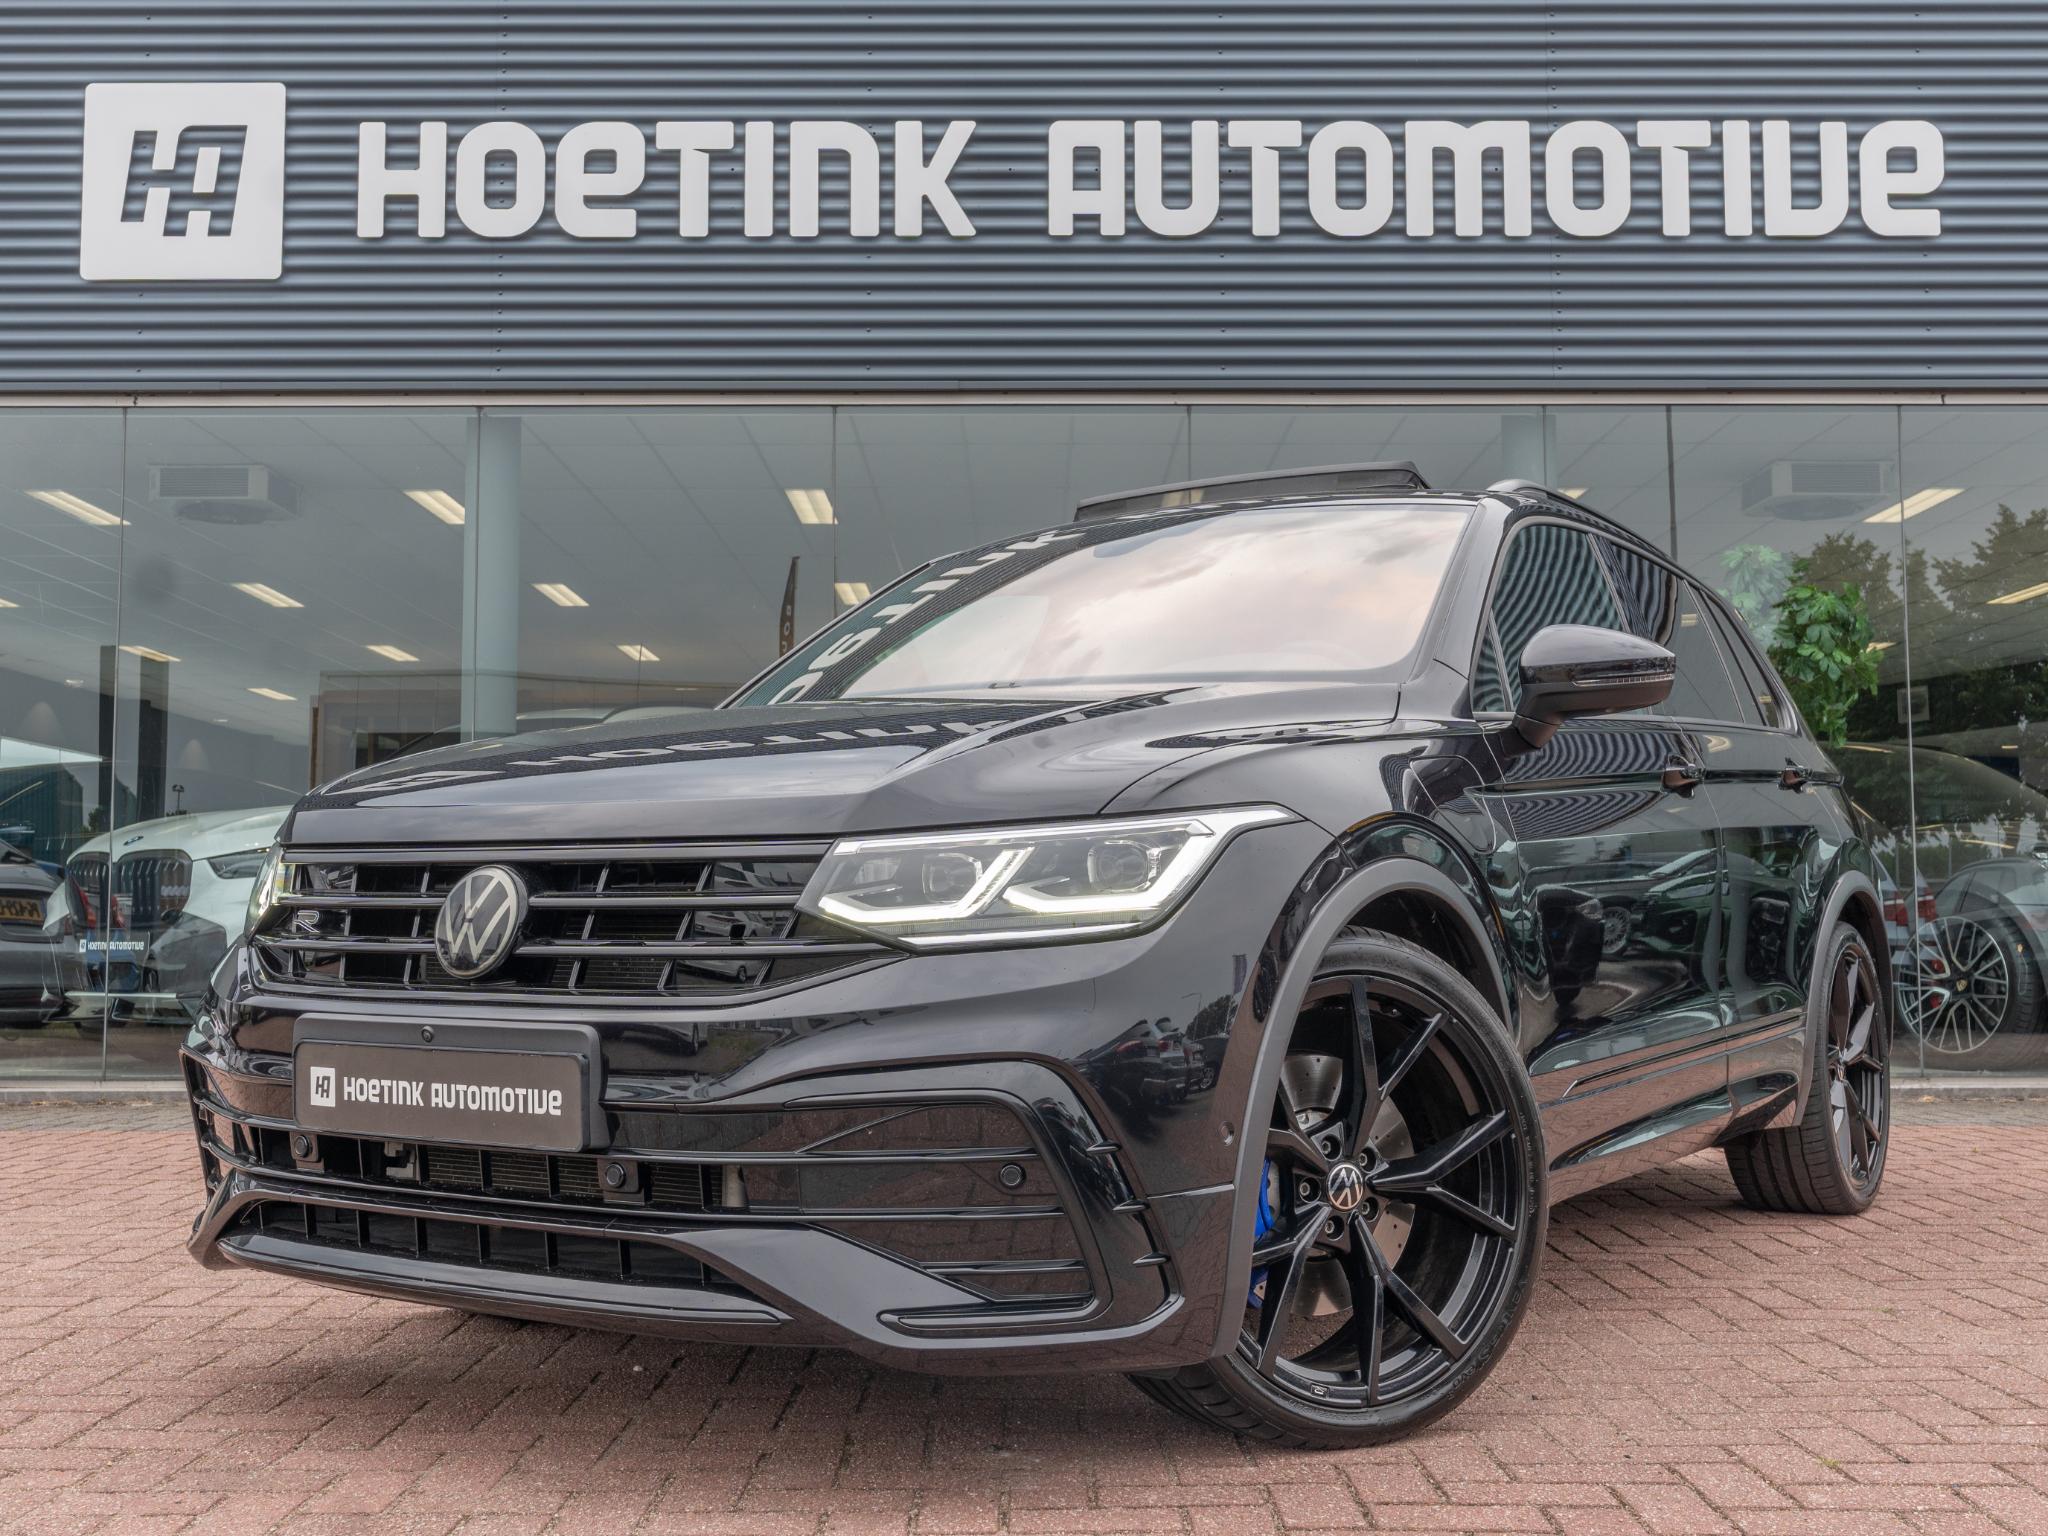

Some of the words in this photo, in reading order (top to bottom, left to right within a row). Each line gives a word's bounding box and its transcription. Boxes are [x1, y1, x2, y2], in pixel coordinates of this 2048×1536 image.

[355, 120, 978, 239] HOETINK
[1046, 119, 1946, 239] AUTOMOTIVE
[343, 1076, 425, 1107] HOETINK
[431, 1082, 563, 1117] AUTOMOTIVE
